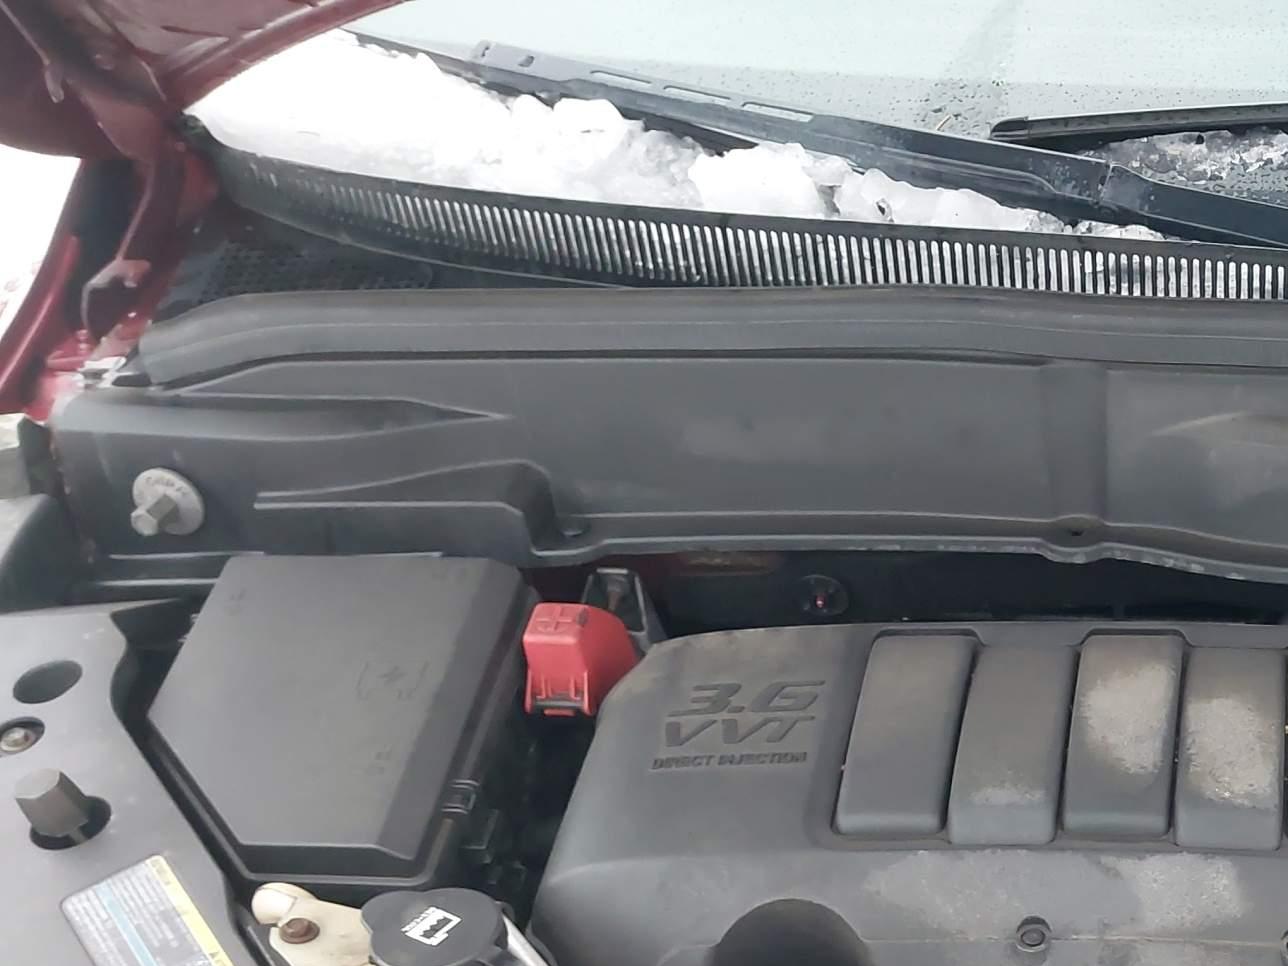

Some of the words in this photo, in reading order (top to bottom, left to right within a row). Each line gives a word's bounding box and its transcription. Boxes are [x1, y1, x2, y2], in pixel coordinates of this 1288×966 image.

[667, 680, 826, 717] 3.6
[665, 715, 815, 747] VVT
[652, 755, 715, 770] DIRECT
[717, 751, 807, 767] INJECTION
